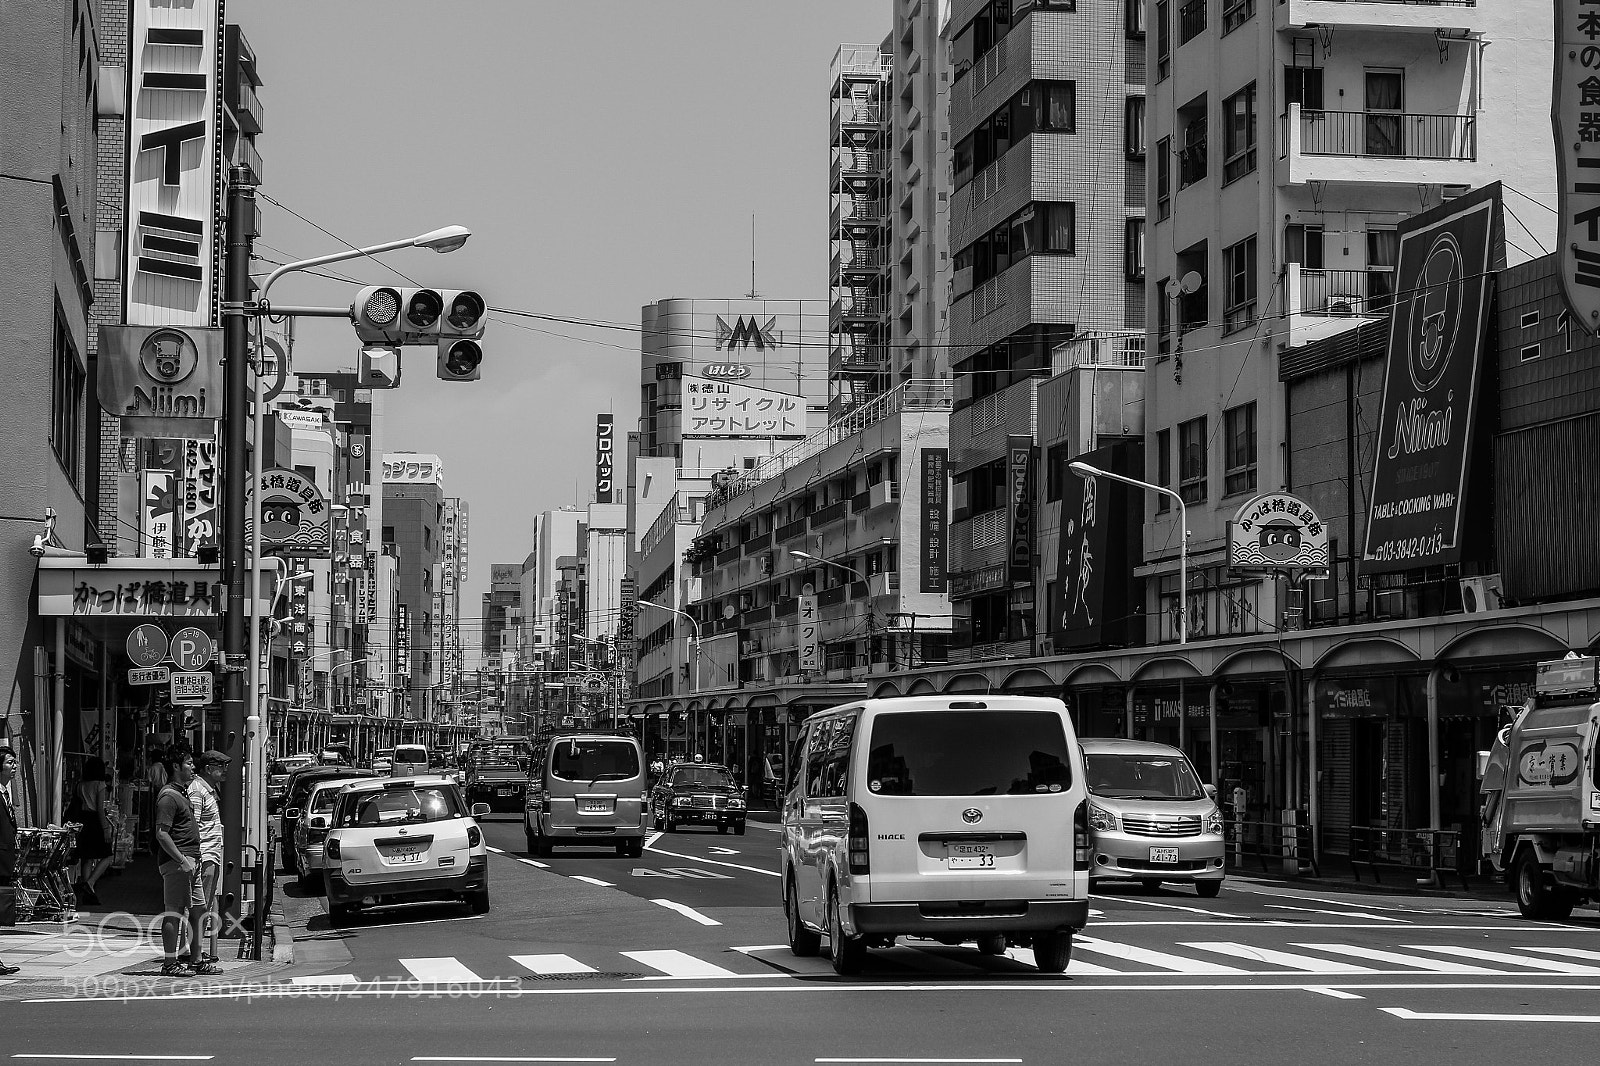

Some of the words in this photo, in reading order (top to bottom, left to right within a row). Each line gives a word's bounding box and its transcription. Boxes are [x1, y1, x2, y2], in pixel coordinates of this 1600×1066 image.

[1577, 0, 1600, 143] 本の食器
[126, 385, 206, 413] Niimi
[691, 397, 796, 412] リサイクル
[283, 412, 321, 423] KAWASAKI
[691, 416, 796, 431] アウトレット
[1388, 390, 1454, 459] Niimi
[598, 423, 613, 492] プロパック
[186, 440, 198, 510] 842-1480
[1011, 452, 1030, 563] Dr.Goods
[75, 581, 215, 606] かっぱ橋道具
[293, 585, 306, 653] 東洋商会
[180, 640, 196, 667] P
[979, 853, 994, 866] 33
